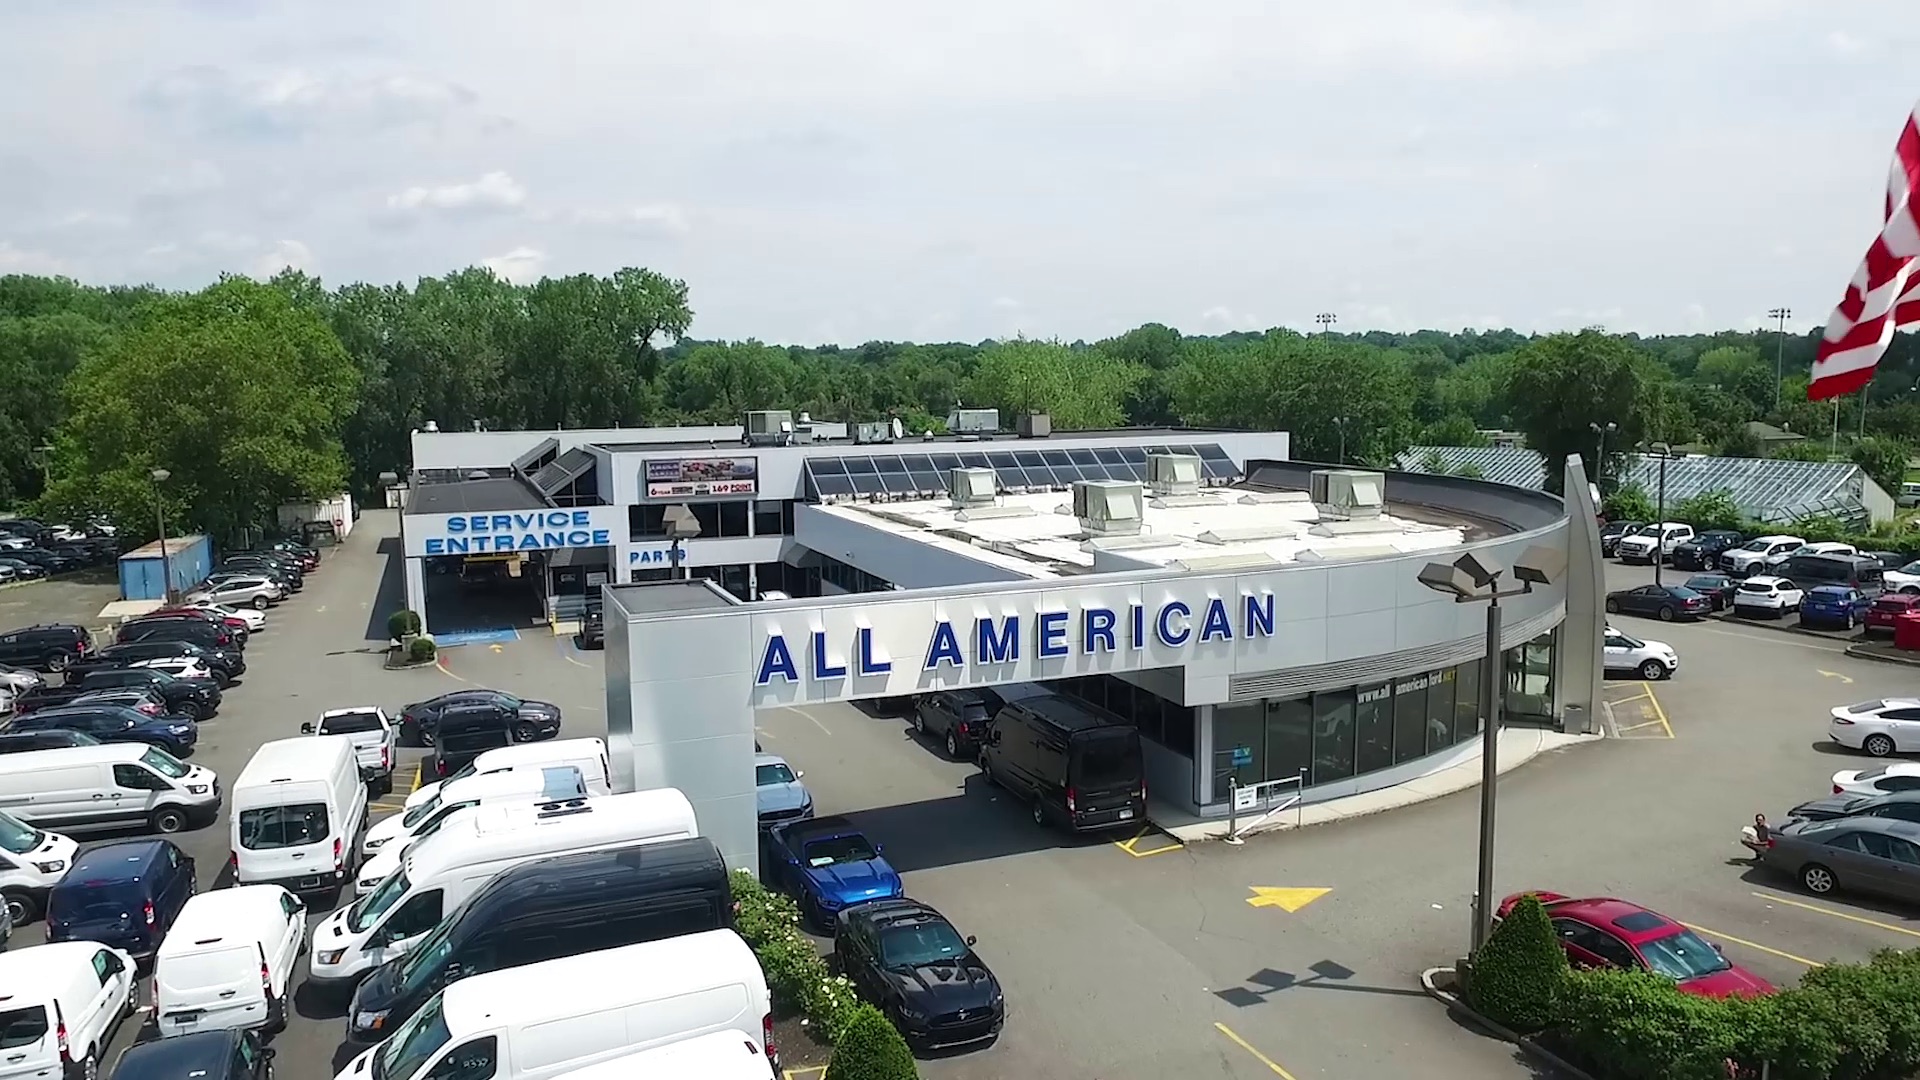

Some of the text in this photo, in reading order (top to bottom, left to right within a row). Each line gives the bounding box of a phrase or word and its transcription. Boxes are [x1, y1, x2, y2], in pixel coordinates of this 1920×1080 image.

[712, 484, 729, 493] 169
[447, 511, 590, 532] SERVICE
[426, 529, 610, 554] ENTRANCE
[755, 593, 1275, 686] ALL AMERICAN
